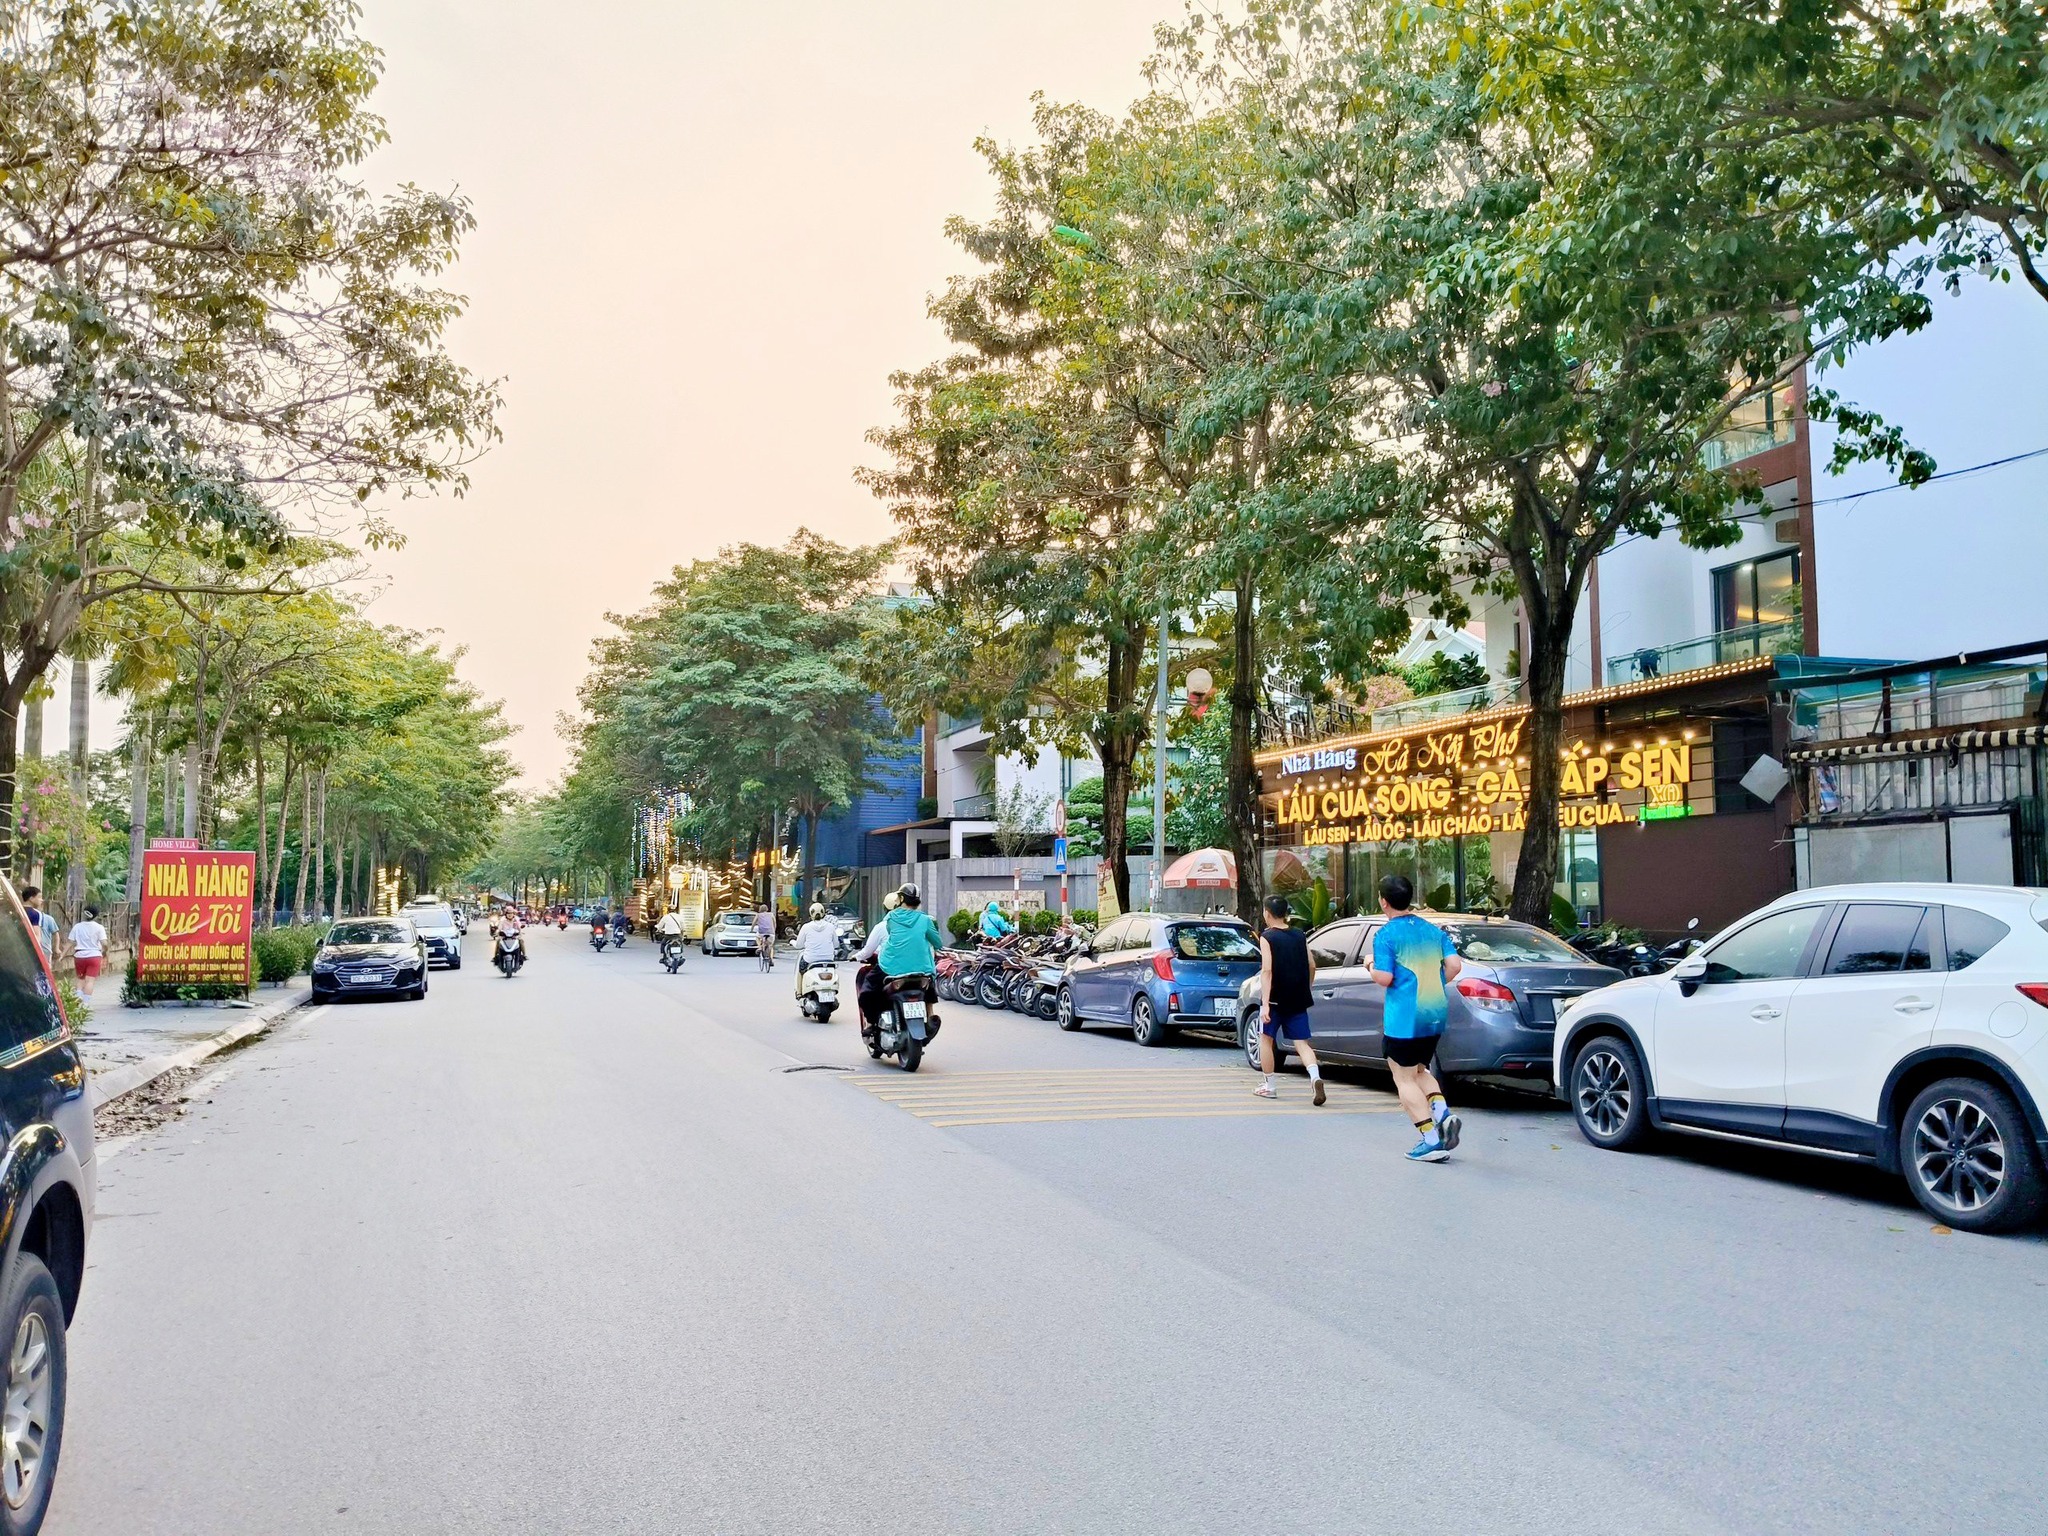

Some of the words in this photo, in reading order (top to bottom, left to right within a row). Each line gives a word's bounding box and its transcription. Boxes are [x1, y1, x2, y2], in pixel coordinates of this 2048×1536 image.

[1282, 753, 1311, 775] Nhà
[1313, 748, 1357, 770] Hàng
[1364, 738, 1410, 775] Hà
[1417, 733, 1465, 768] Nội
[1469, 716, 1526, 760] Phố
[1278, 782, 1315, 825] LẨU
[1322, 788, 1370, 820] CUA
[1376, 774, 1451, 814] SÔNG
[1561, 740, 1609, 794] ẤP
[1620, 745, 1690, 789] SEN
[152, 840, 174, 849] HOME
[175, 840, 197, 849] VILLA
[1327, 826, 1350, 844] SEN
[1443, 808, 1492, 834] CHÁO
[148, 858, 189, 897] NHÀ
[195, 858, 249, 897] HÀNG
[150, 903, 201, 941] Quê
[208, 903, 243, 934] Tôi
[143, 942, 173, 960] CHUYÊN
[174, 942, 189, 960] CÁC
[190, 942, 209, 960] MÓN
[231, 942, 246, 961] QUÊ
